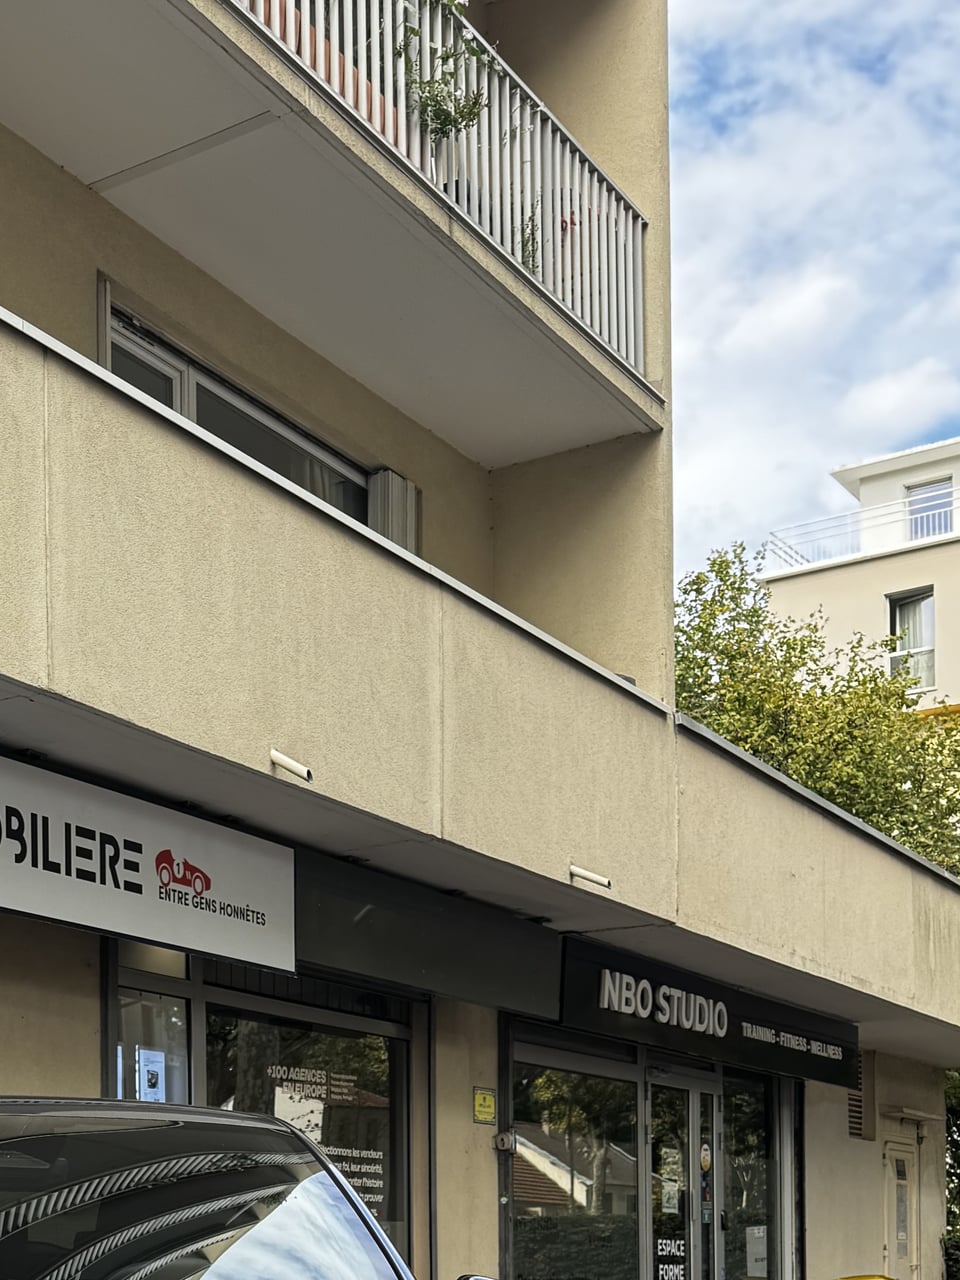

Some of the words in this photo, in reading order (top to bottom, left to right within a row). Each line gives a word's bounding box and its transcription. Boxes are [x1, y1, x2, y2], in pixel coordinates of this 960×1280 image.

[158, 886, 189, 907] ENTRE
[192, 893, 217, 914] GENS
[219, 898, 266, 927] HONNÊTES
[599, 968, 653, 1019] NBO
[654, 985, 728, 1038] STUDIO
[741, 1022, 776, 1043] TRAINING
[780, 1032, 807, 1052] FITNESS
[811, 1040, 843, 1060] WELLNESS
[267, 1065, 288, 1079] +100
[288, 1067, 327, 1083] AGENCES
[282, 1081, 294, 1095] EN
[295, 1083, 327, 1098] EUROPE
[657, 1239, 685, 1256] ESPACE
[658, 1264, 685, 1280] FORME
